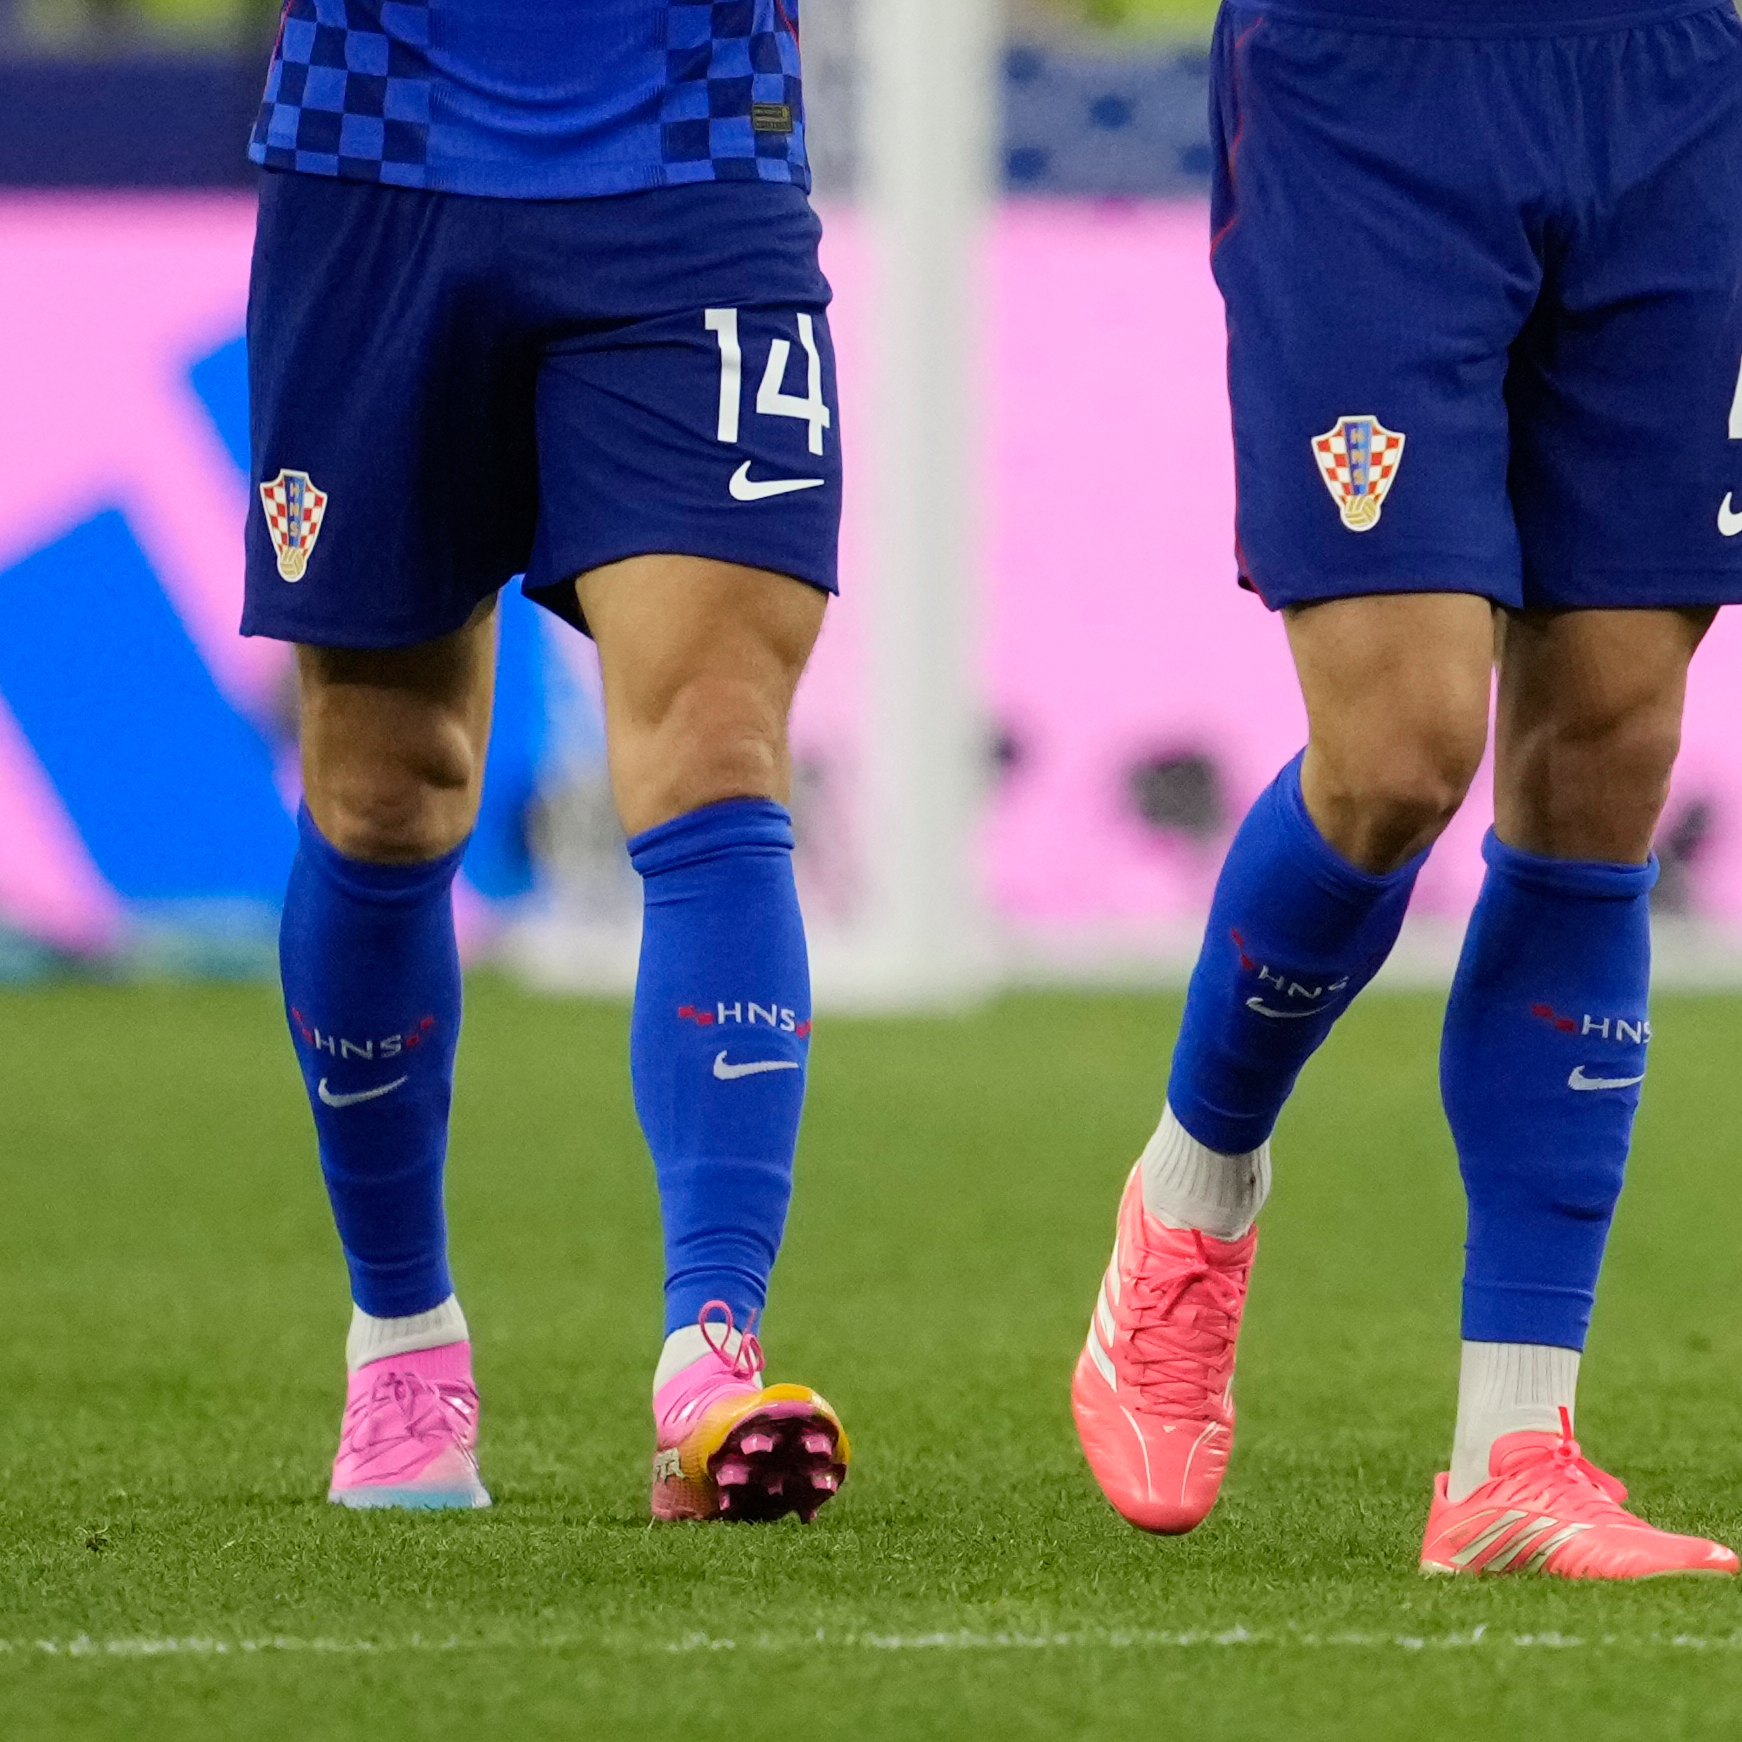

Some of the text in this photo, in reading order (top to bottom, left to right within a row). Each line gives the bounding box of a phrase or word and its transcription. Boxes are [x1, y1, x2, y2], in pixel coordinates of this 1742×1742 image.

[704, 308, 831, 456] 14
[717, 1002, 796, 1033] HNS
[1581, 1013, 1654, 1045] HNS
[314, 1027, 402, 1061] HNS
